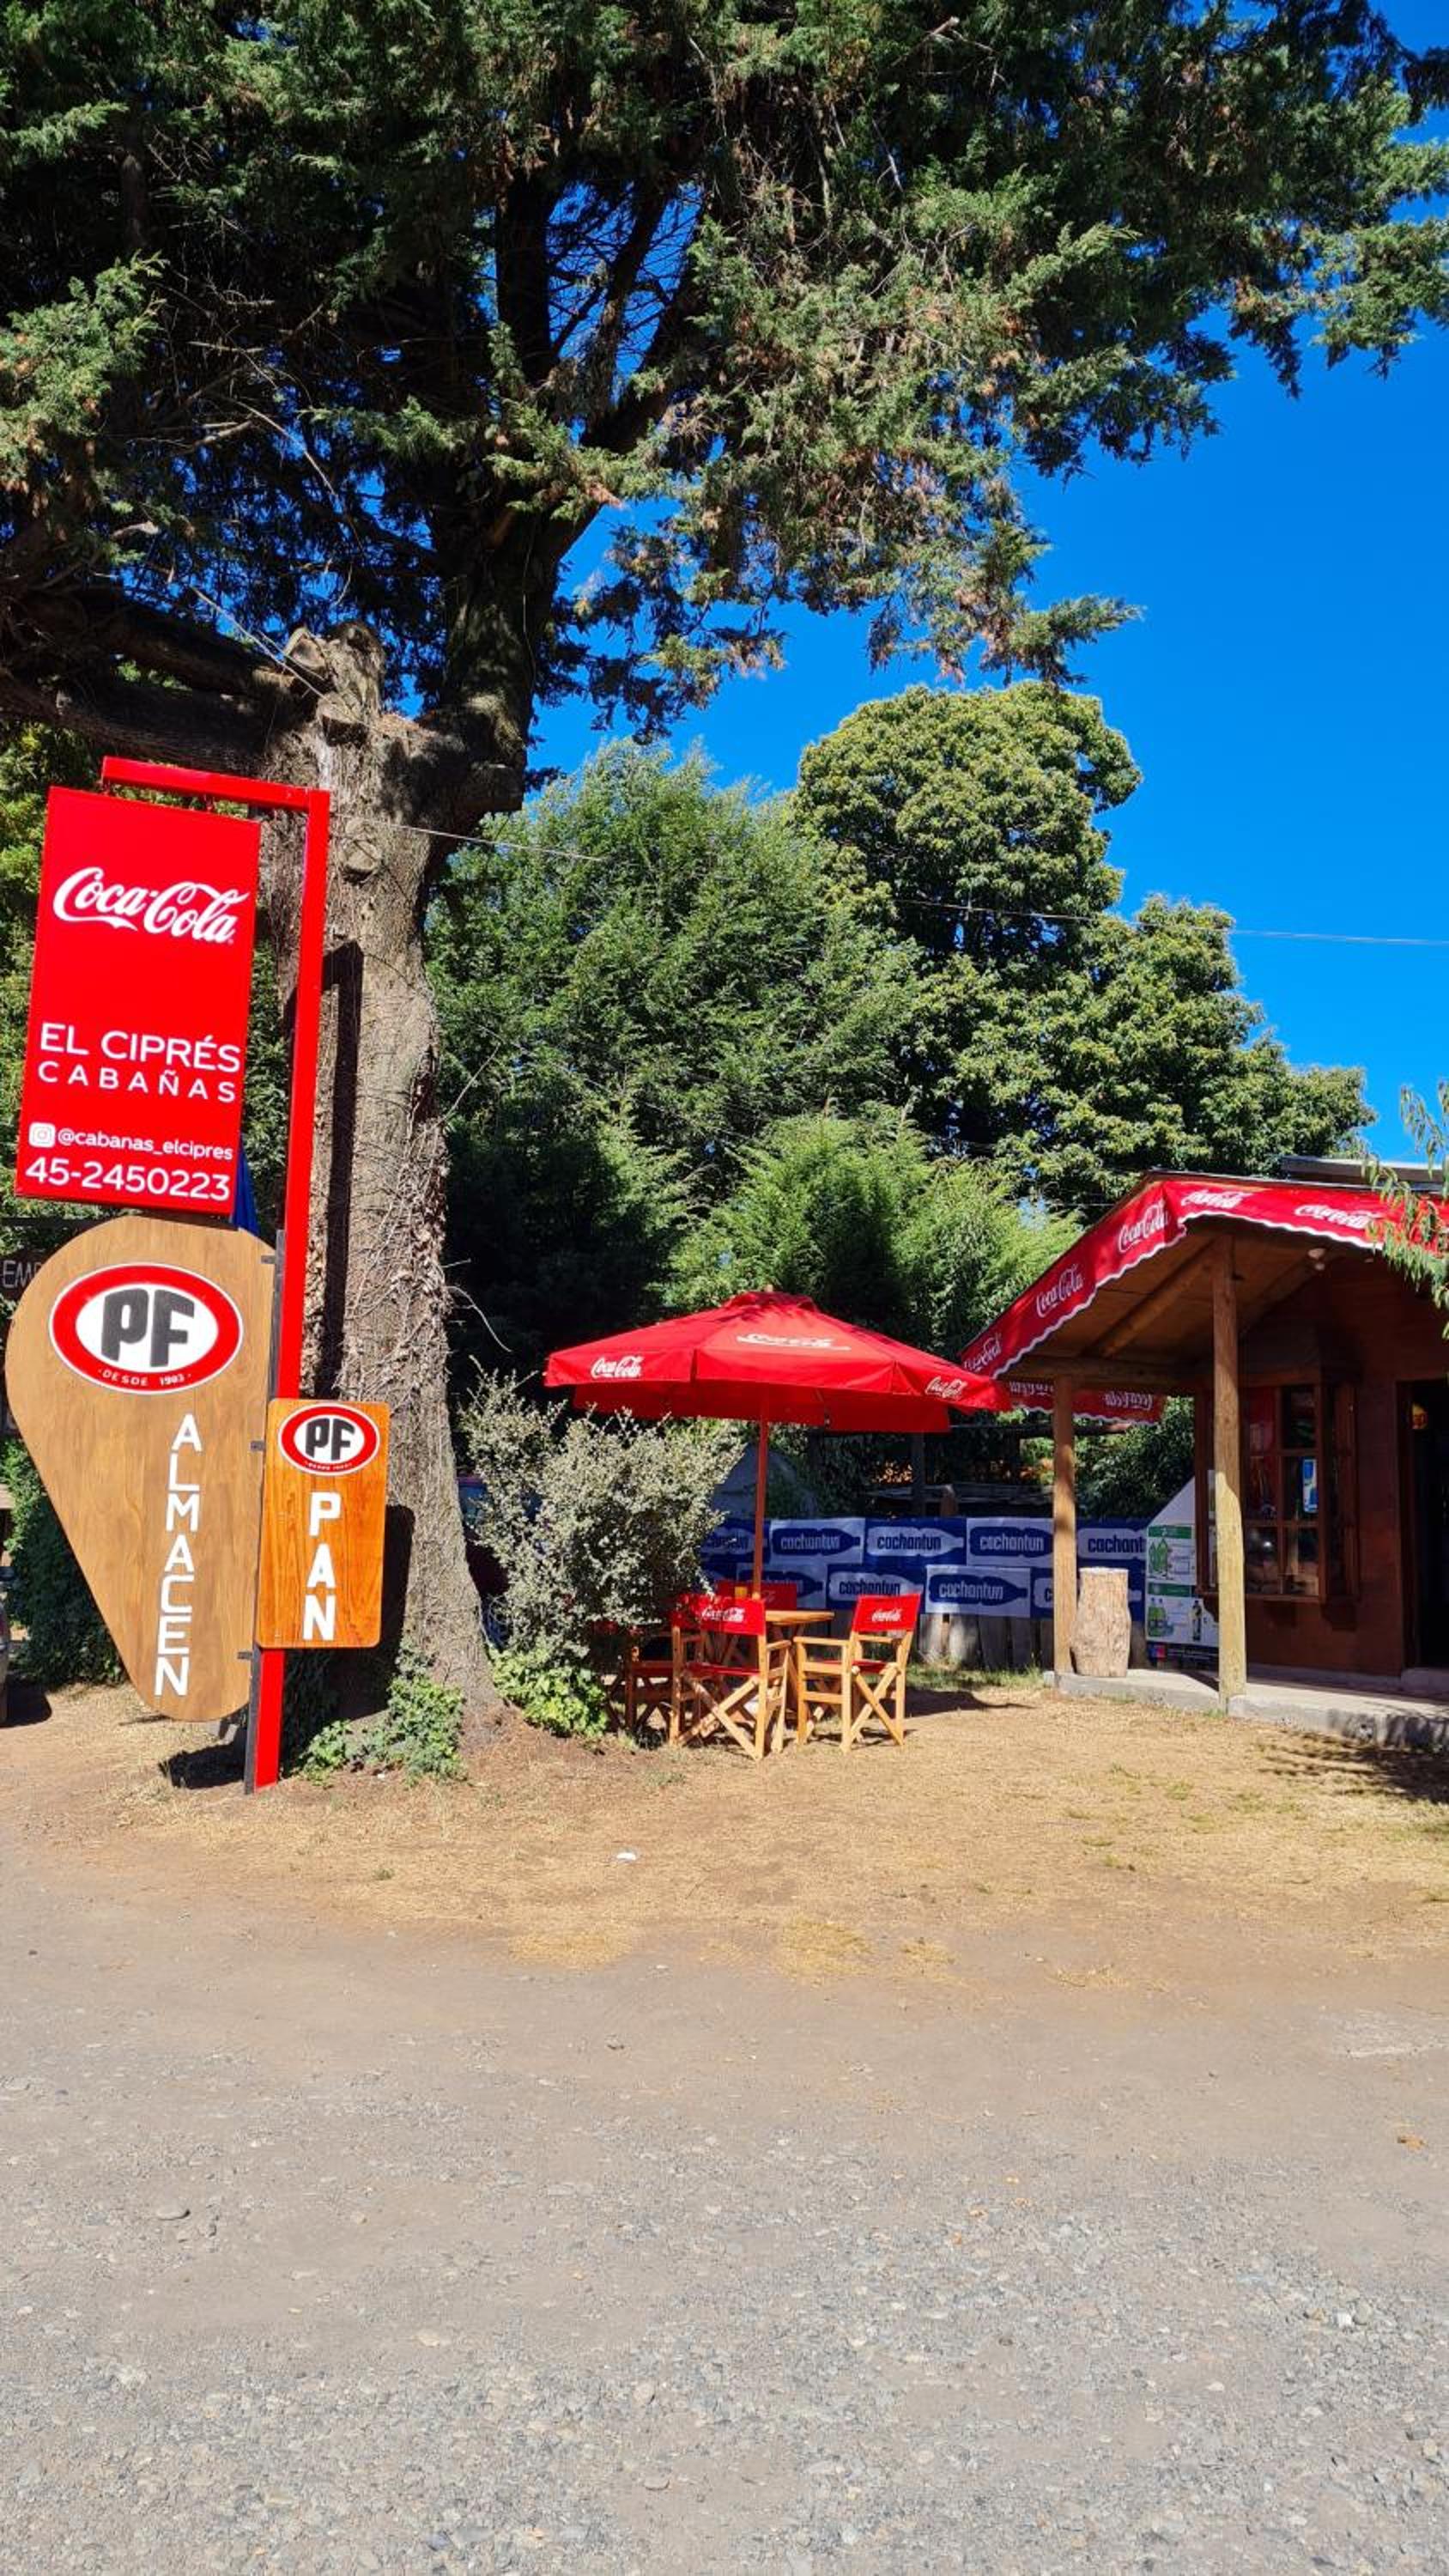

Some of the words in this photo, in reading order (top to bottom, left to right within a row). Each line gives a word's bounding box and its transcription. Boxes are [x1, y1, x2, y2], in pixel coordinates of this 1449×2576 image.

[52, 866, 249, 943] Coca-Cola
[39, 1023, 89, 1055] EL
[100, 1030, 241, 1072] CIPRÉS
[38, 1060, 236, 1103] CABAÑAS
[57, 1127, 233, 1161] @cabanas_elcipres
[25, 1157, 232, 1201] 45-2450223
[1119, 1198, 1169, 1254] Coca-Cola
[1036, 1263, 1086, 1318] Coca-Cola
[100, 1288, 195, 1368] PF
[306, 1418, 355, 1461] PF
[154, 1413, 203, 1697] ALMACEN
[303, 1492, 341, 1641] PAN
